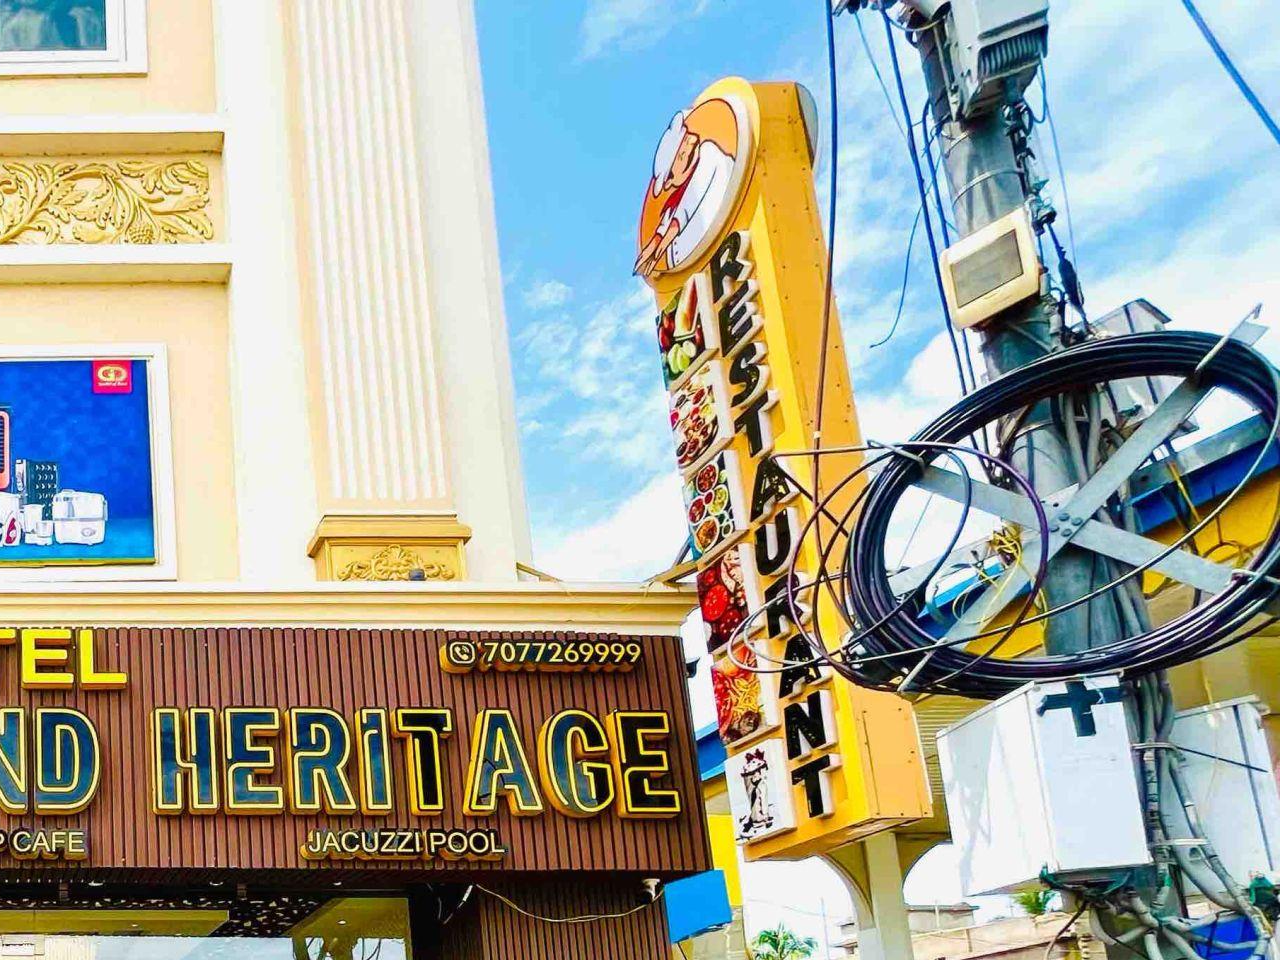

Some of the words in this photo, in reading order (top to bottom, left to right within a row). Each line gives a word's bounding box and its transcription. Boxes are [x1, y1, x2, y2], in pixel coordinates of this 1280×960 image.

[710, 231, 838, 818] RESTAURANT
[484, 639, 642, 666] 7077269999
[151, 707, 683, 818] HERITAGE
[13, 830, 87, 856] CAFE
[307, 829, 421, 856] JACUZZI
[429, 829, 508, 856] POOL
